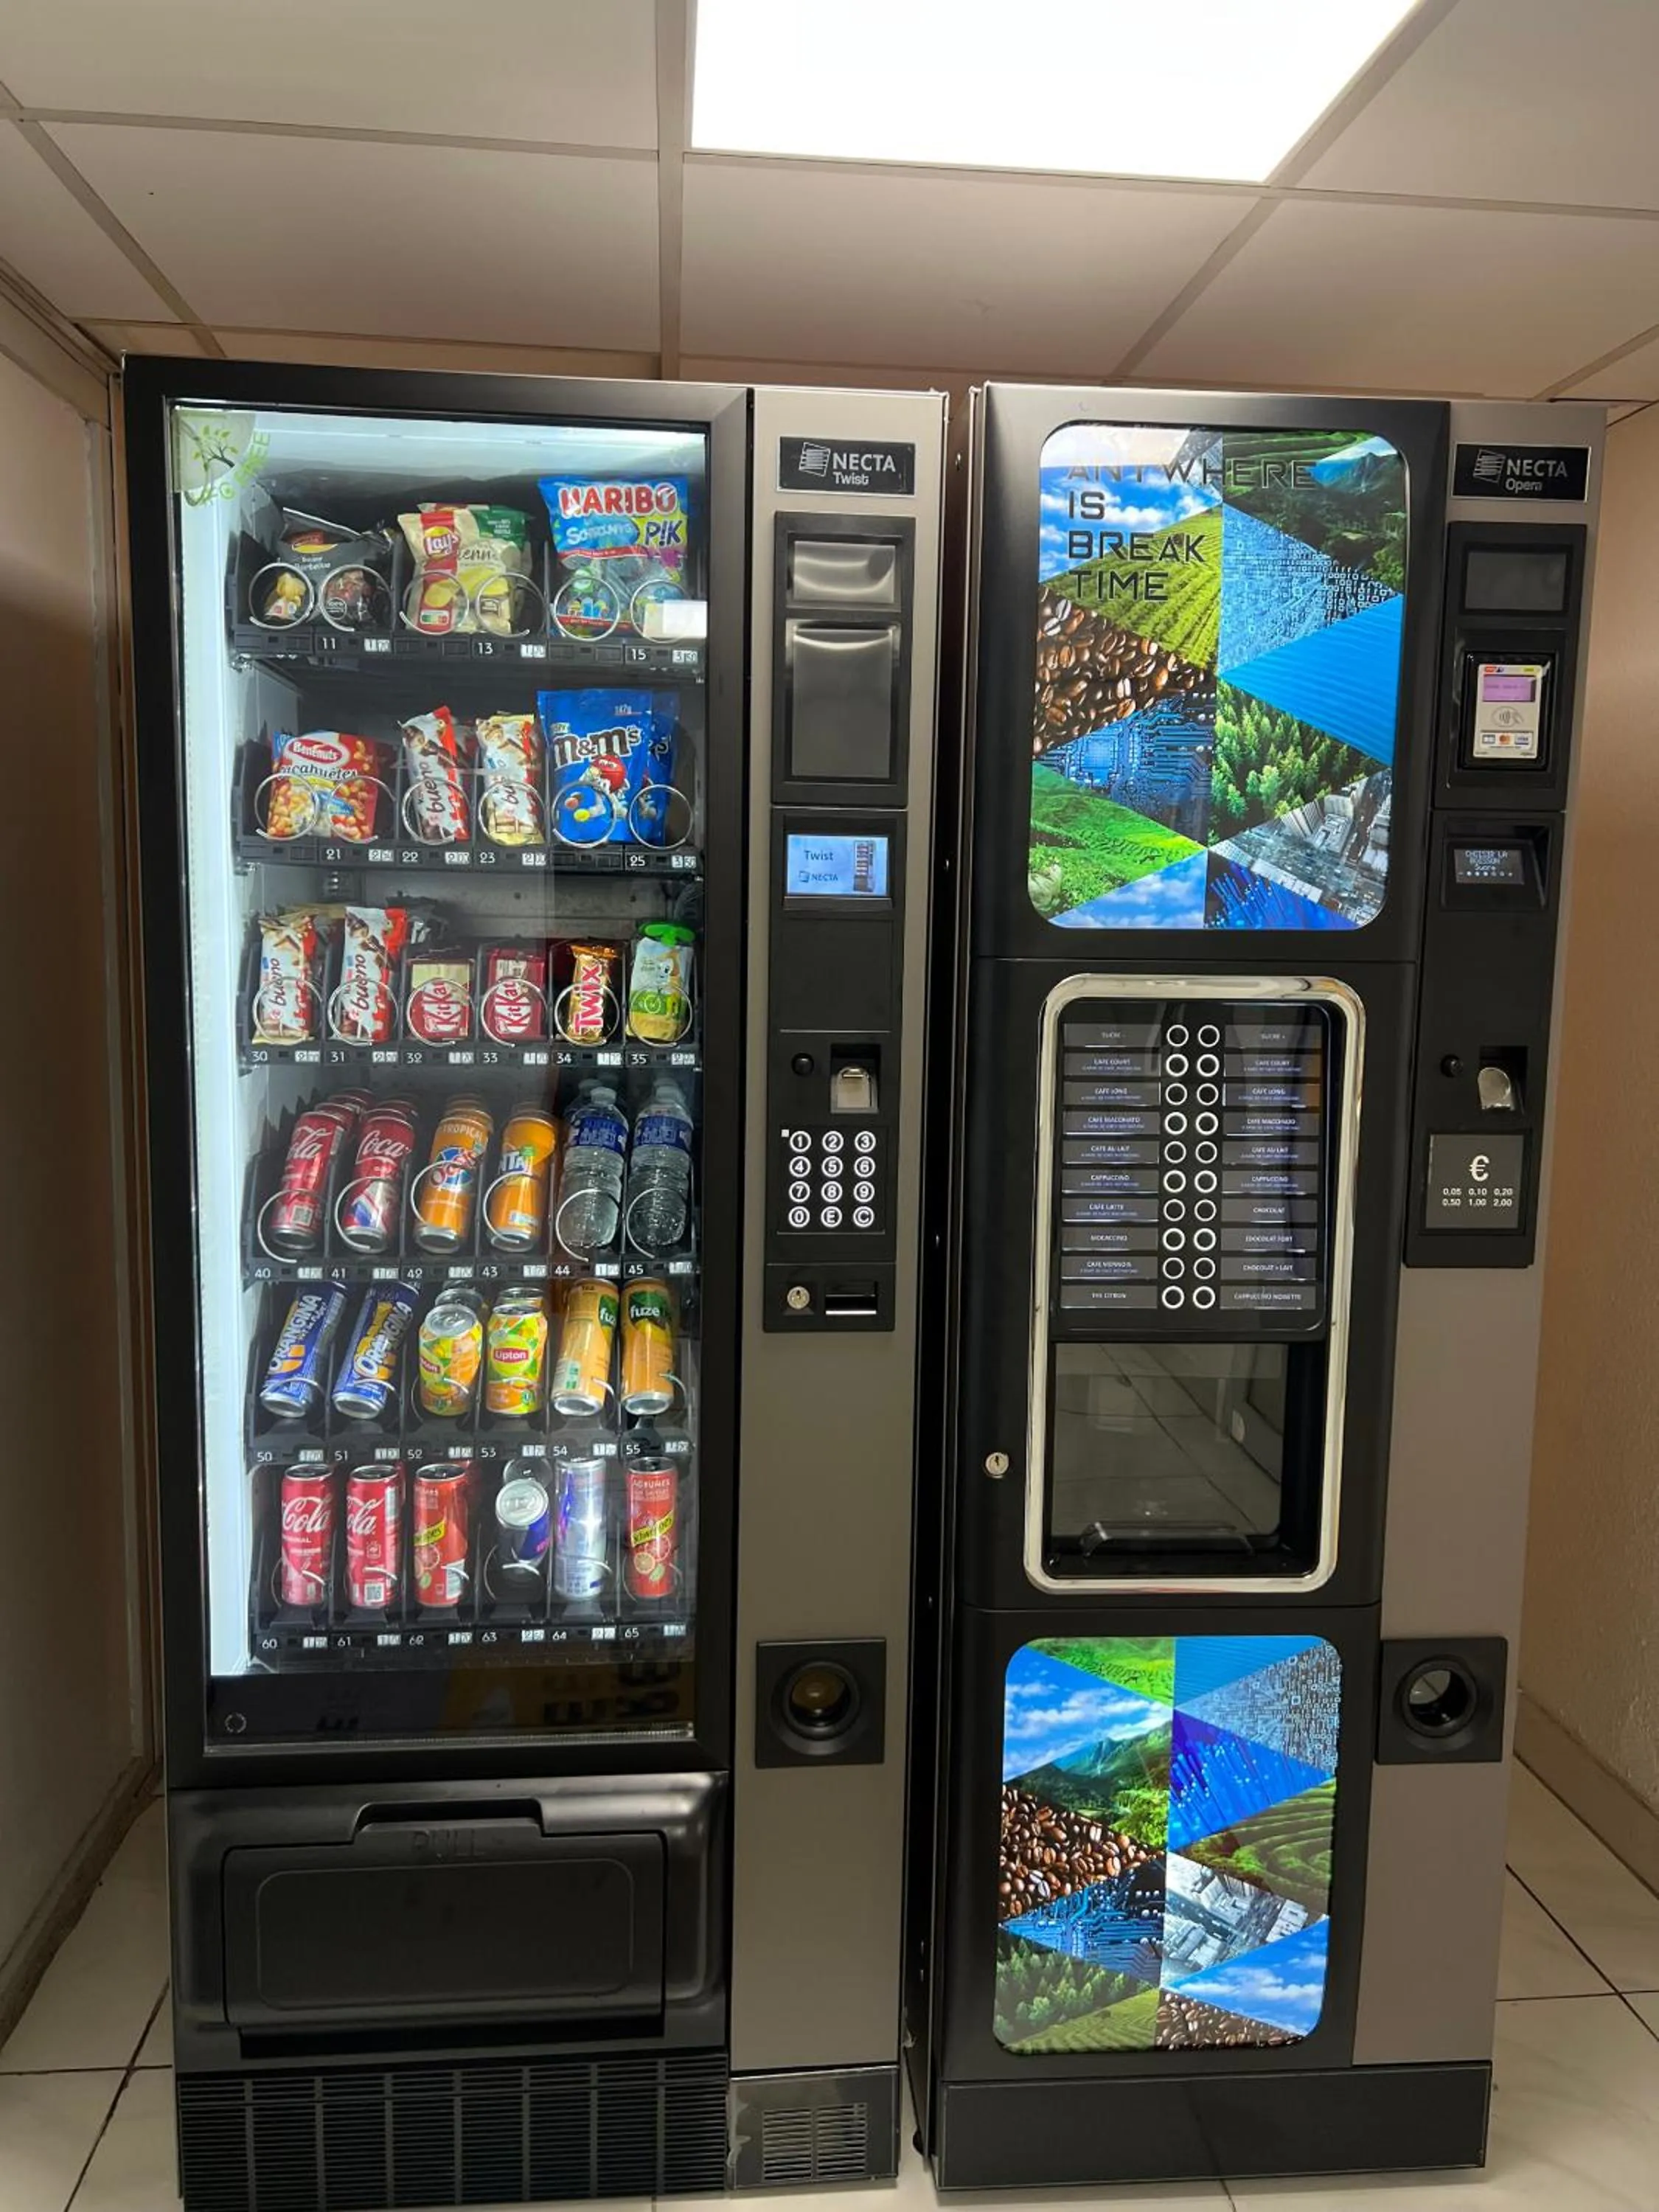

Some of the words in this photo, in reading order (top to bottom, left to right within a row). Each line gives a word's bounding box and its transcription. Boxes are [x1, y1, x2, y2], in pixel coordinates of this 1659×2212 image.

[832, 453, 896, 472] NECTA
[1067, 458, 1320, 490] ANYWHERE
[1506, 459, 1568, 478] NECTA
[833, 472, 869, 485] Twist
[559, 483, 677, 518] HARIBO
[1068, 490, 1105, 521] IS
[425, 532, 459, 554] Lay's
[1068, 529, 1207, 564] BREAK
[1068, 569, 1169, 603] TIME
[322, 639, 335, 649] 11
[478, 642, 493, 654] 13
[631, 648, 647, 660] 15
[419, 762, 445, 813] bueno
[327, 849, 341, 860] 21
[403, 852, 418, 862] 22
[480, 852, 495, 863] 23
[804, 850, 834, 861] Twist
[630, 856, 645, 866] 25
[811, 873, 838, 881] NECTA
[269, 959, 287, 1006] bueno
[351, 954, 369, 1010] bueno
[573, 964, 602, 1035] Twix
[252, 1051, 268, 1062] 30
[330, 1052, 344, 1062] 31
[407, 1054, 422, 1062] 32
[483, 1054, 498, 1062] 33
[557, 1053, 571, 1063] 34
[631, 1054, 648, 1064] 35
[1469, 1155, 1490, 1182] €
[255, 1268, 271, 1279] 40
[331, 1268, 346, 1279] 41
[407, 1268, 422, 1279] 42
[481, 1267, 498, 1277] 43
[554, 1265, 570, 1276] 44
[628, 1265, 644, 1274] 45
[599, 1308, 616, 1325] fuz
[630, 1306, 660, 1318] fuze
[268, 1294, 322, 1372] ORANGINA
[356, 1301, 413, 1376] ORANGINA
[495, 1350, 527, 1362] Lipton
[408, 1449, 422, 1459] 52
[481, 1447, 496, 1458] 53
[554, 1446, 568, 1455] 54
[626, 1444, 641, 1454] 55
[257, 1452, 272, 1462] 50
[335, 1451, 348, 1461] 51
[481, 1632, 497, 1642] 63
[553, 1632, 567, 1641] 64
[625, 1628, 639, 1638] 65
[262, 1638, 277, 1649] 60
[338, 1636, 351, 1646] 61
[409, 1635, 424, 1645] 62
